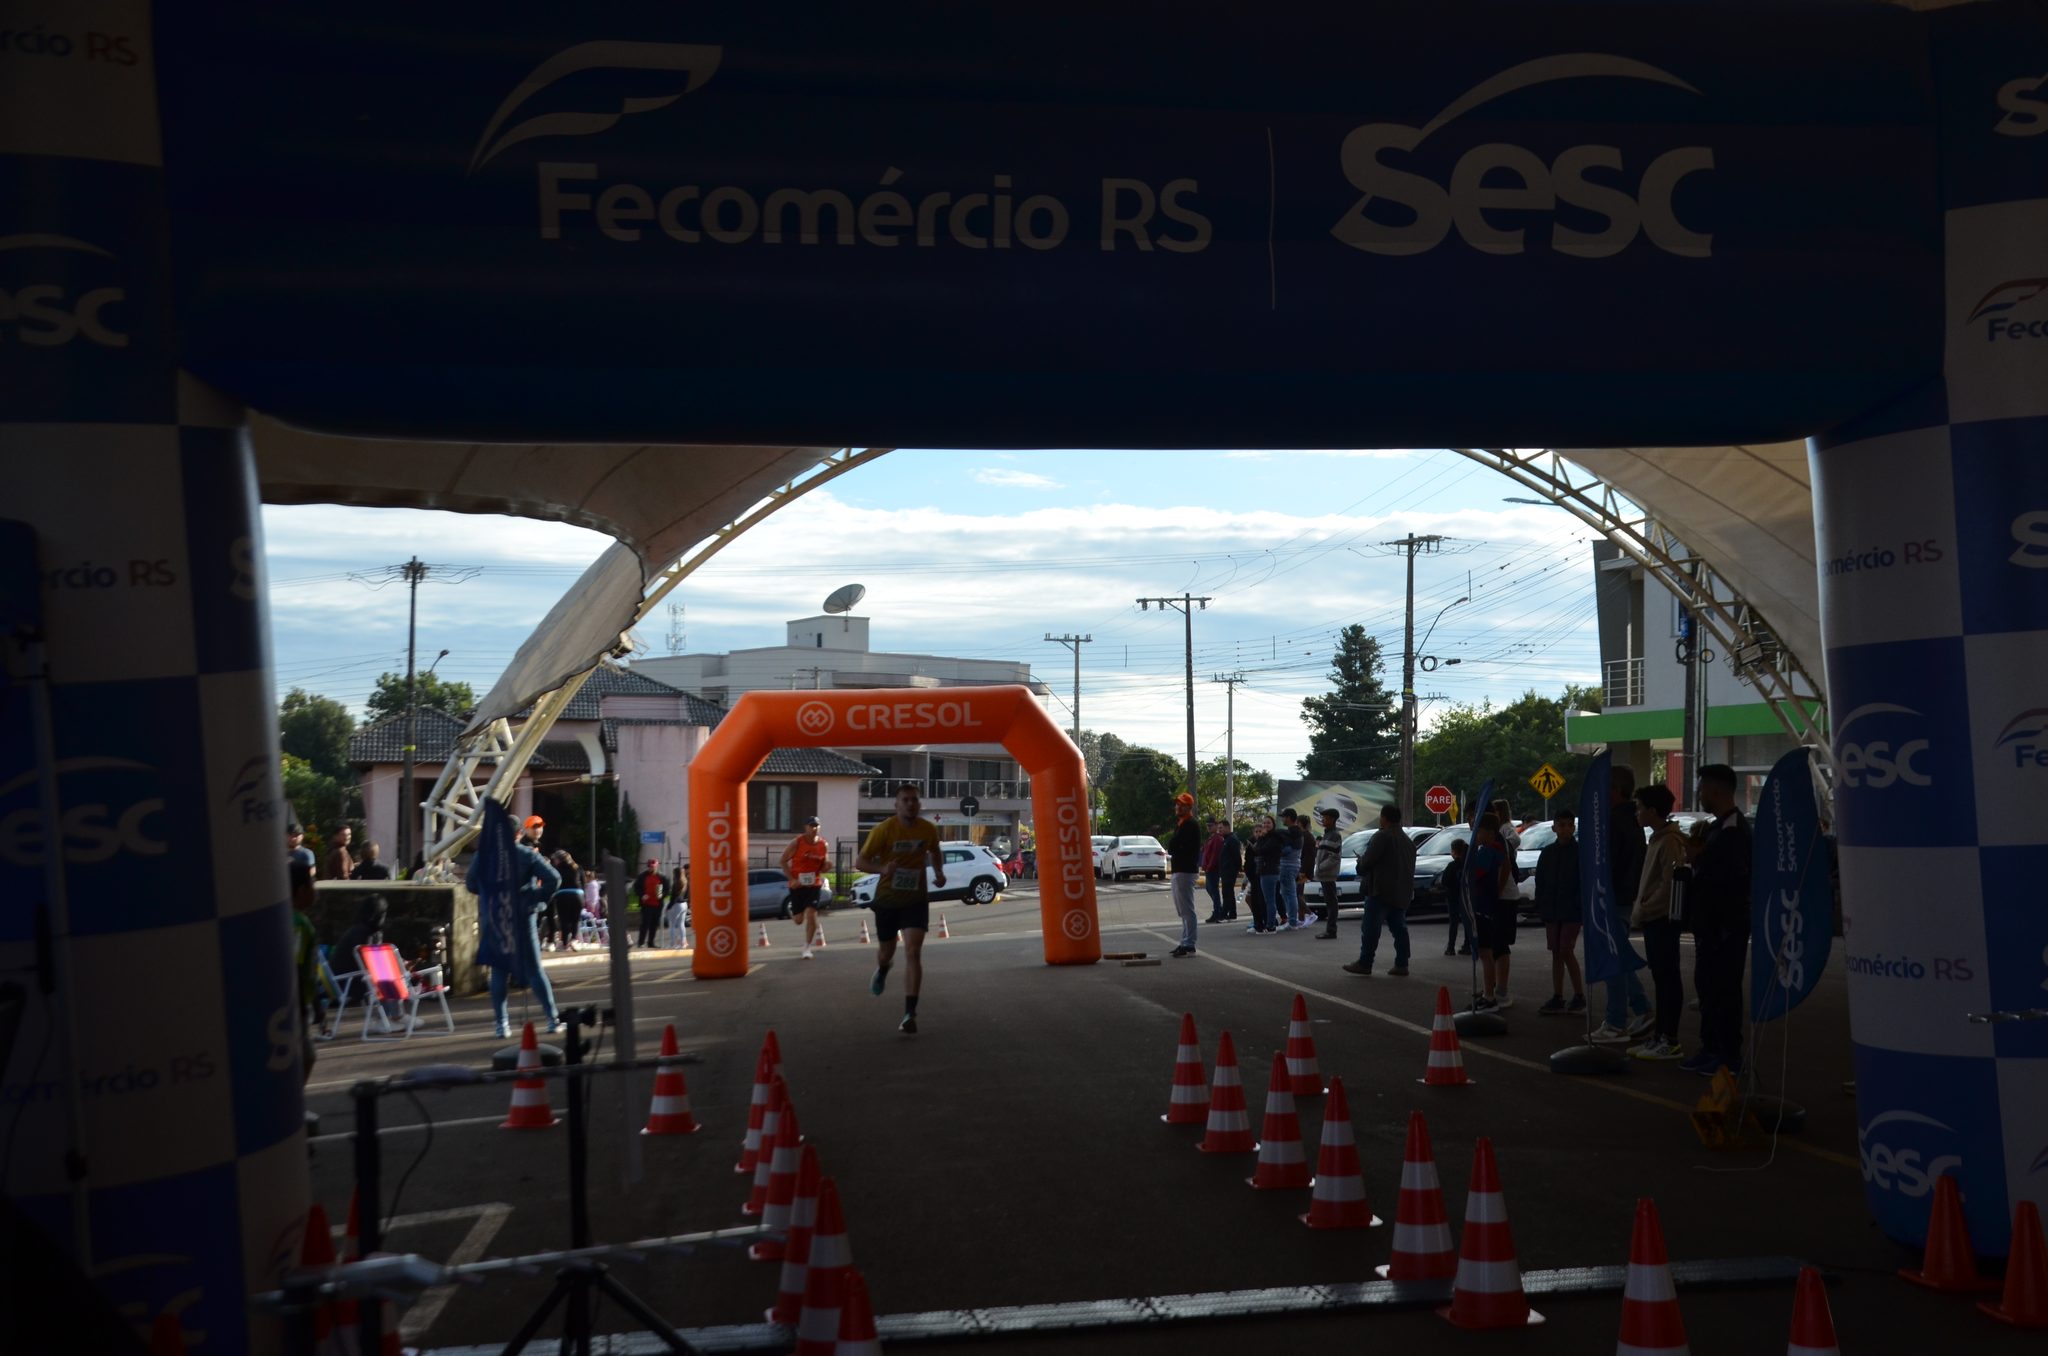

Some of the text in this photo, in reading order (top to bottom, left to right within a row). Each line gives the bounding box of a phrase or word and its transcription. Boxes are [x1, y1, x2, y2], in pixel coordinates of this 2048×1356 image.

[87, 31, 140, 67] RS
[1330, 116, 1716, 259] Sesc
[540, 165, 1213, 254] Fecomércio RS
[1904, 539, 1944, 565] RS
[128, 558, 177, 588] RS
[845, 701, 983, 730] CRESOL
[1427, 795, 1451, 805] PARE
[708, 801, 733, 918] CRESOL
[1056, 786, 1084, 901] CRESOL
[1776, 888, 1805, 992] Sesc
[1934, 958, 1974, 981] RS
[169, 1051, 215, 1085] RS
